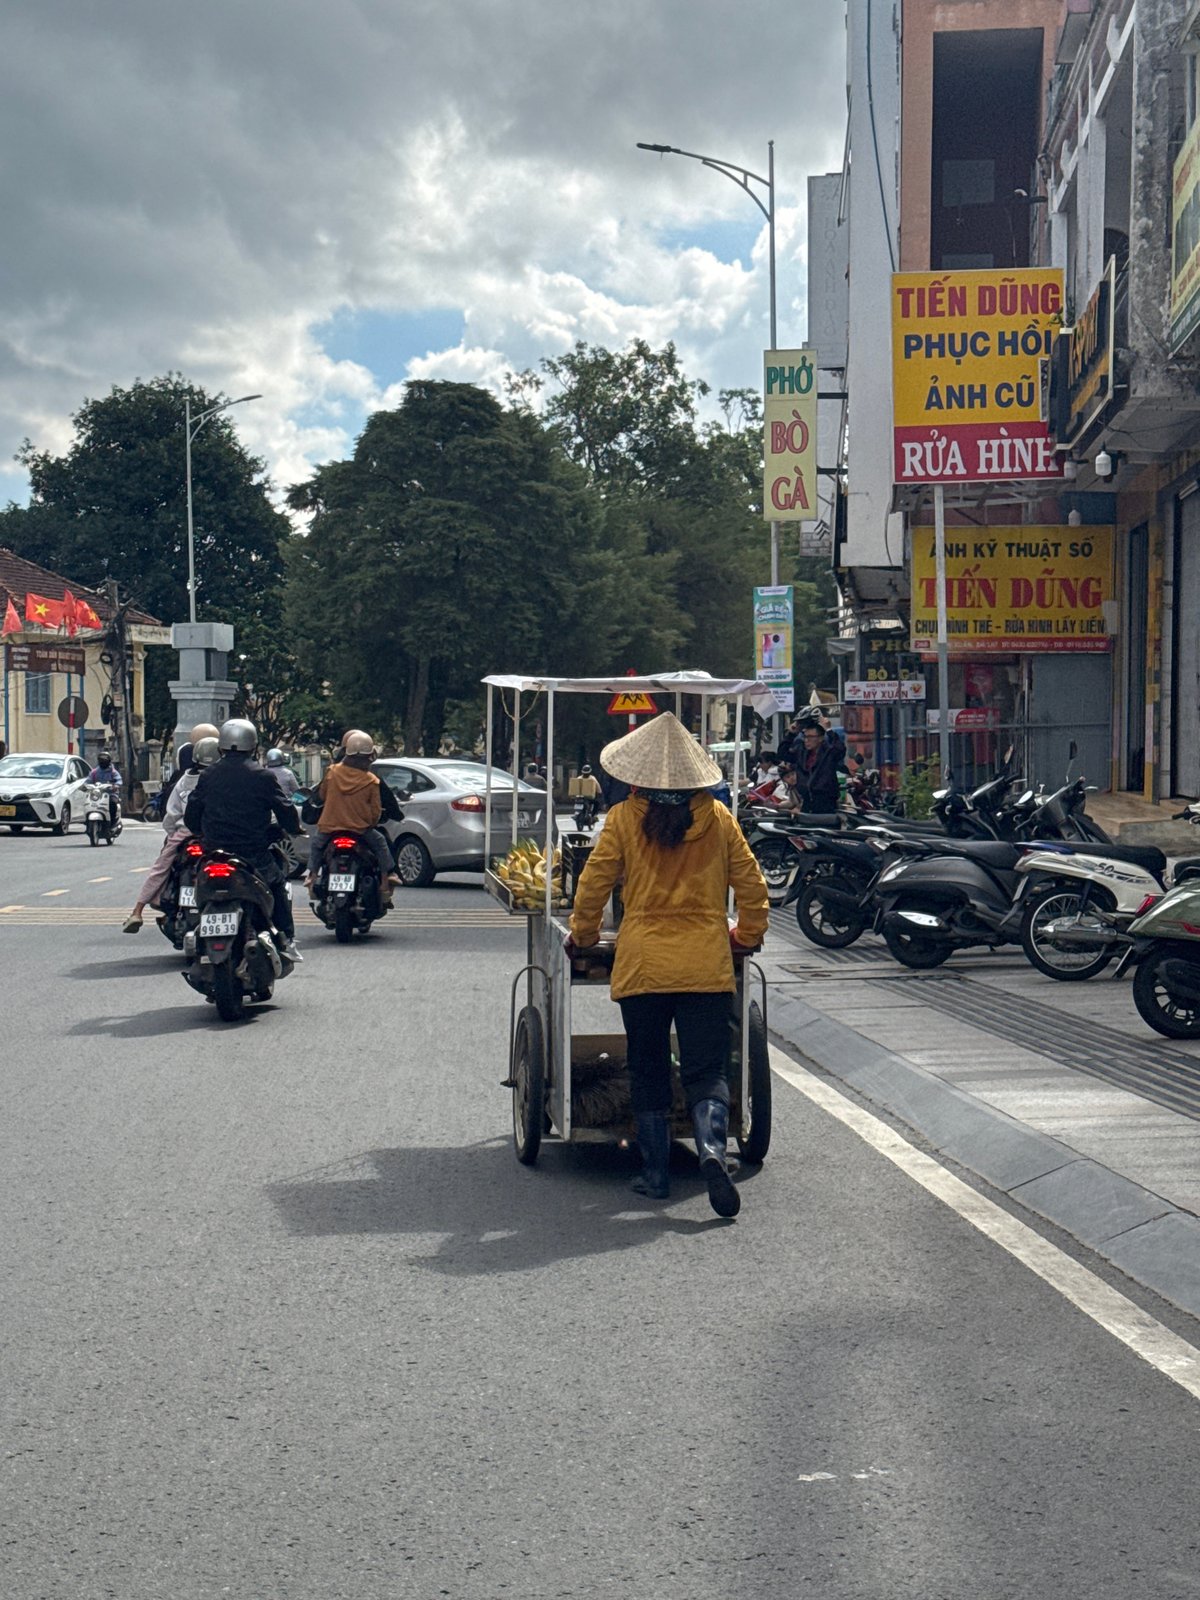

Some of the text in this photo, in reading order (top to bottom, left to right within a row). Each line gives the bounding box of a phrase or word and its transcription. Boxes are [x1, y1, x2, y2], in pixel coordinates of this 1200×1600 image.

[896, 275, 1061, 318] TIẾN DŨNG
[904, 319, 1052, 366] PHỤC HỒI
[766, 355, 814, 395] PHỞ
[925, 374, 1035, 411] ẢNH CŨ
[771, 409, 809, 454] BÒ
[902, 427, 1059, 477] RỬA HÌNH
[771, 466, 809, 511] GÀ
[973, 538, 998, 558] KỸ
[1005, 538, 1061, 562] THUẬT
[1069, 535, 1095, 558] SỐ
[919, 563, 1103, 609] TIẾN DŨNG
[206, 913, 232, 924] 49-B1
